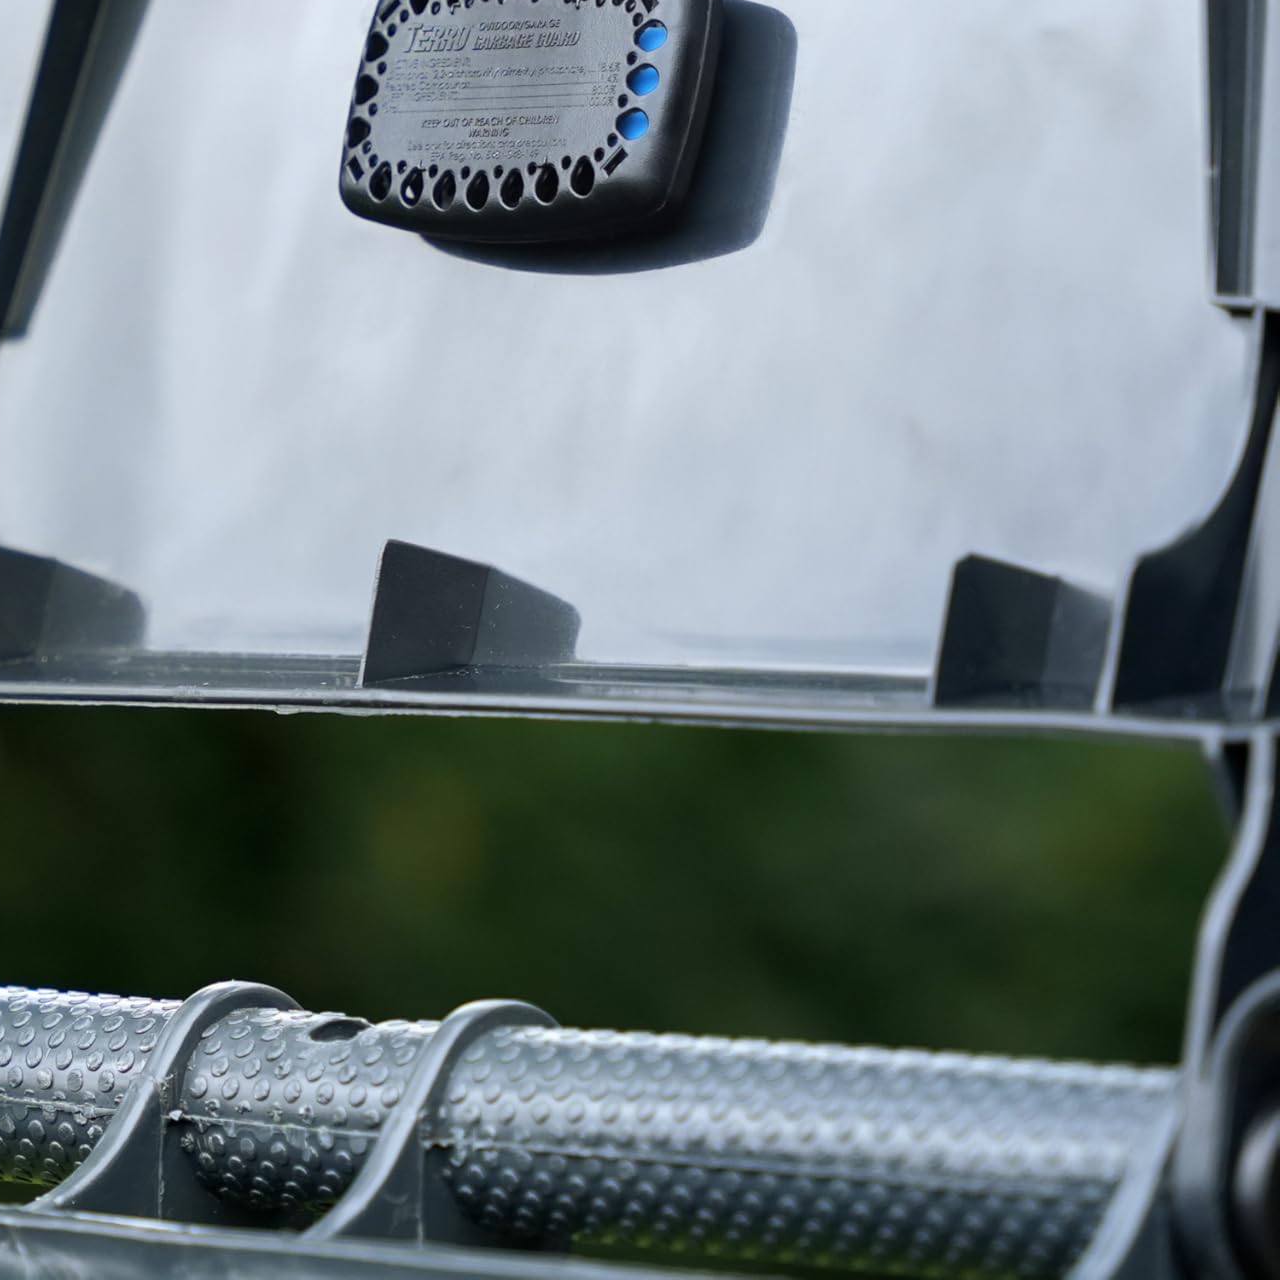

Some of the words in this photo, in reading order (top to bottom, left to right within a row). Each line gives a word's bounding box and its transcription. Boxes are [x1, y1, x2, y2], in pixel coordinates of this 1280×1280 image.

[403, 24, 472, 53] TERRO
[472, 33, 535, 51] GARBAGE
[535, 31, 581, 49] GUARD
